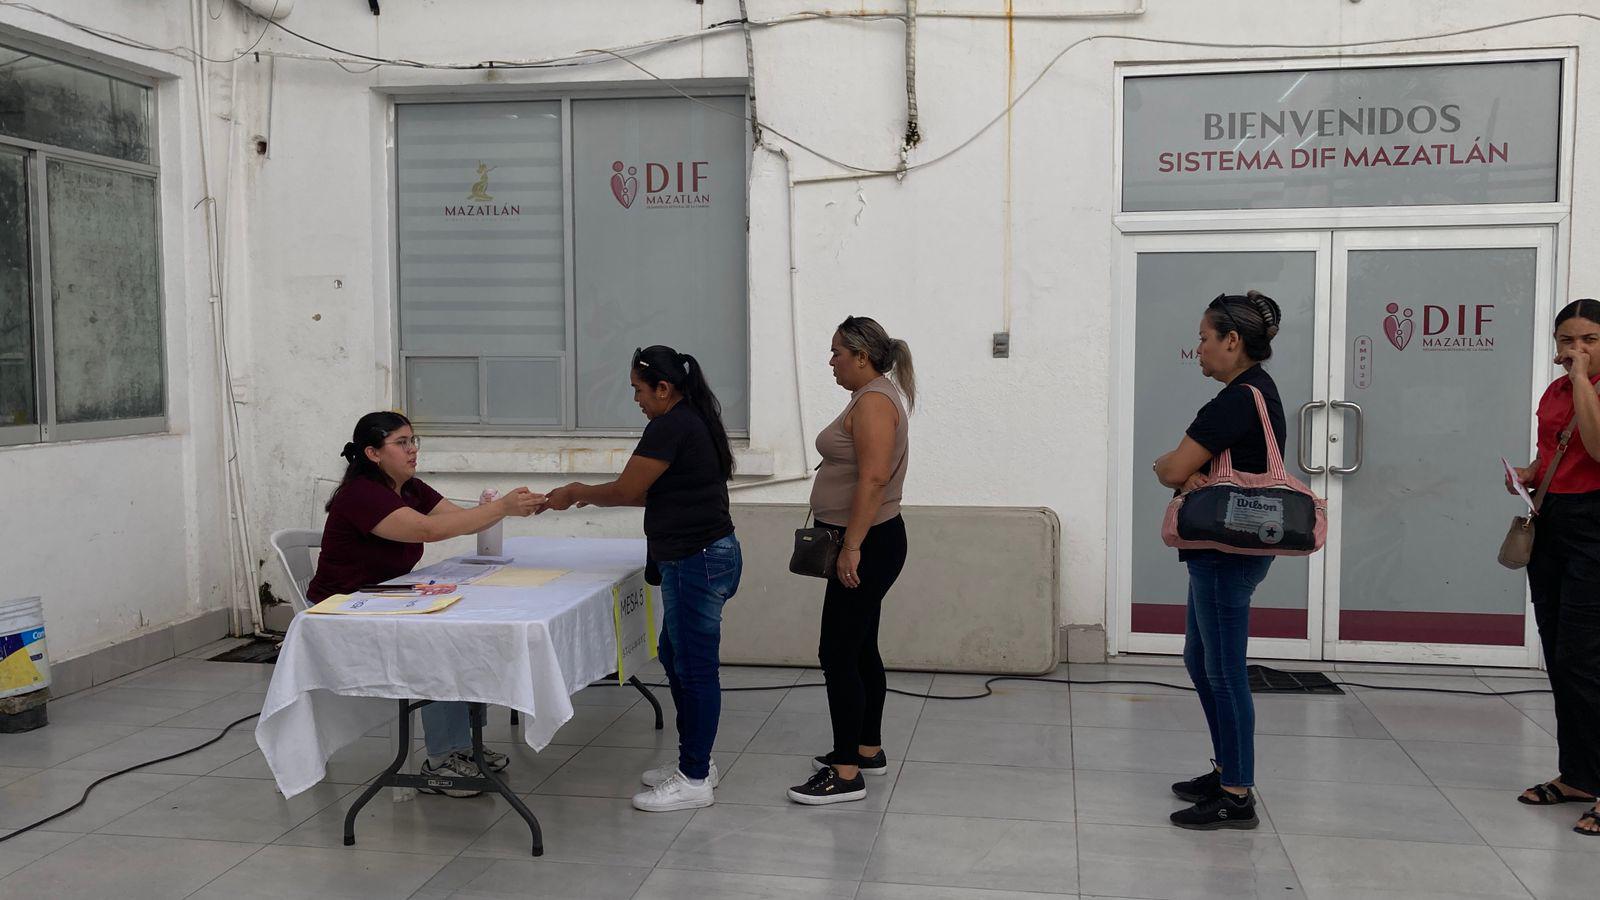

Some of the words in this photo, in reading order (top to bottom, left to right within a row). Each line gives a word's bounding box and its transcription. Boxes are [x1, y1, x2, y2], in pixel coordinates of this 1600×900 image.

[1203, 104, 1462, 141] BIENVENIDOS
[1158, 148, 1284, 173] SISTEMA
[1290, 147, 1336, 169] DIF
[1343, 136, 1509, 168] MAZATLÁN
[645, 161, 709, 194] DIF
[444, 202, 520, 217] MAZATLÁN
[1423, 304, 1495, 336] DIF
[1237, 499, 1277, 511] Wilson
[621, 592, 639, 618] MESA
[640, 588, 644, 606] 5
